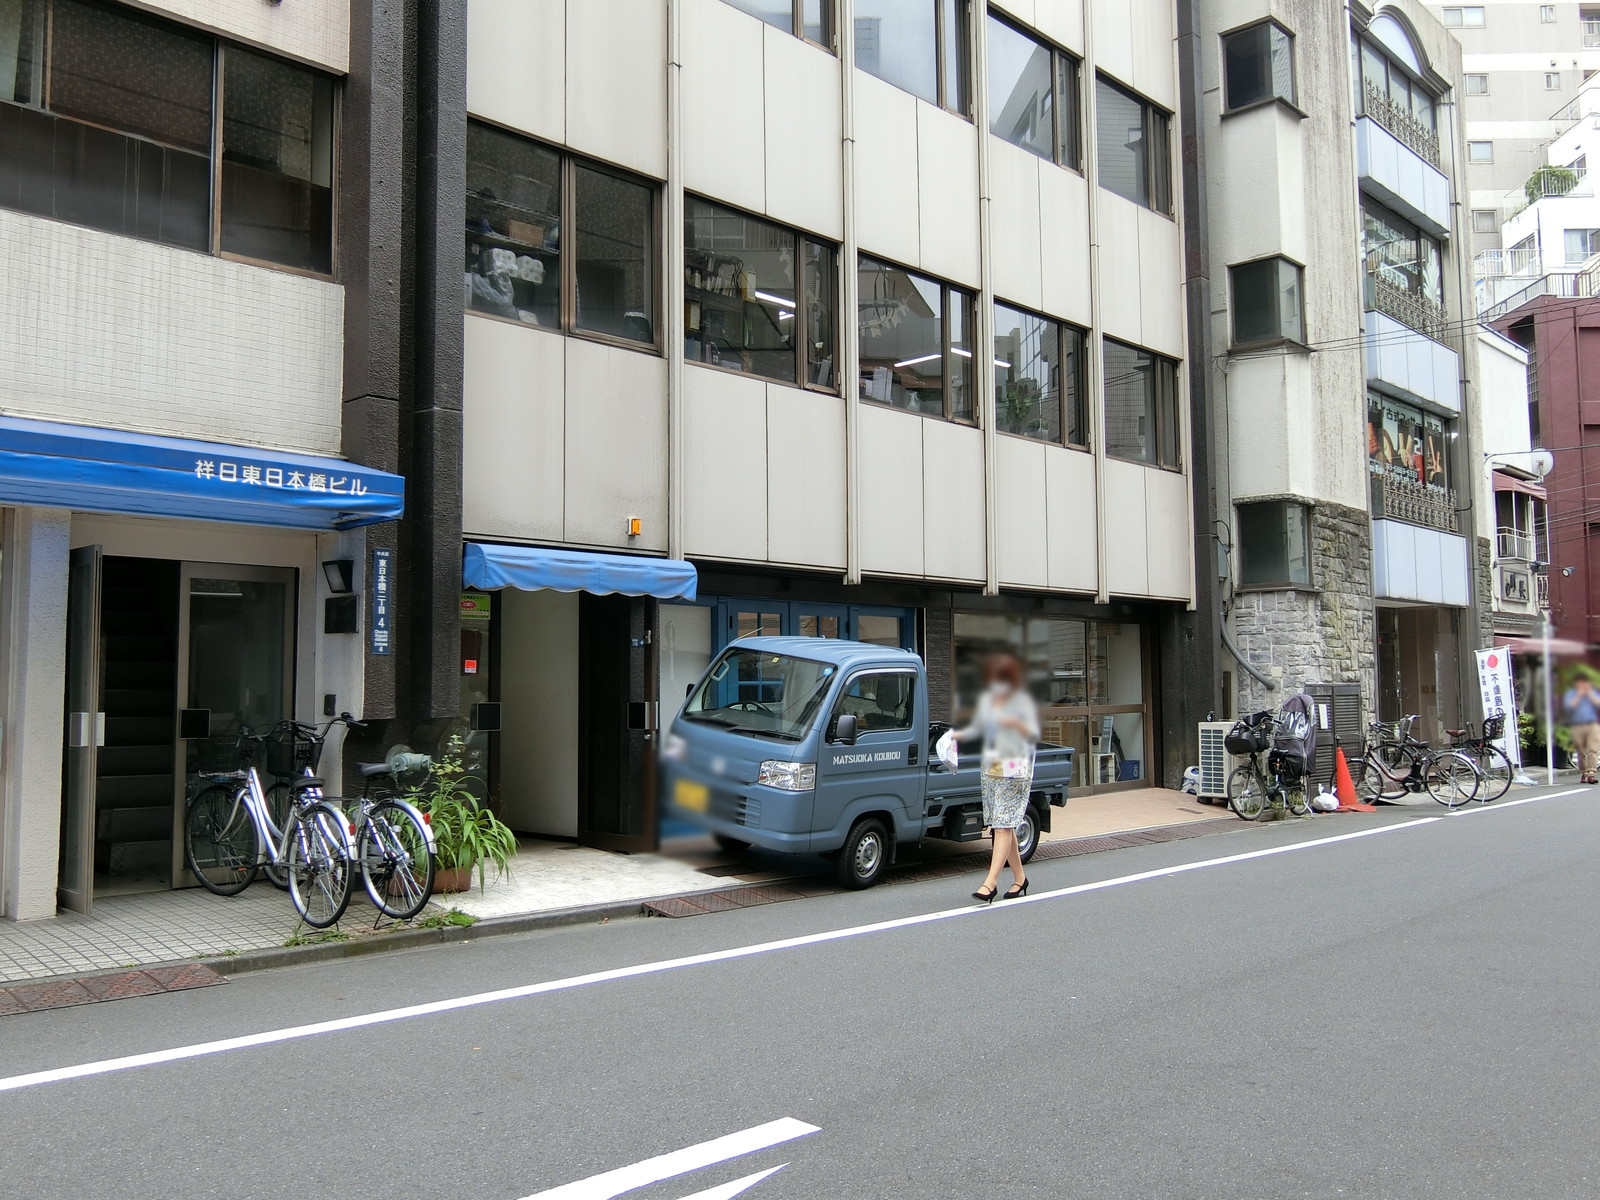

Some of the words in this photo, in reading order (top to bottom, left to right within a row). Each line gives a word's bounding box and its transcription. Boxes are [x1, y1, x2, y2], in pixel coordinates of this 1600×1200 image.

[194, 459, 367, 496] 祥日東日本橋ビル
[378, 617, 385, 628] 4
[832, 753, 873, 765] MATSUOKA
[874, 751, 901, 762] KOUBOU
